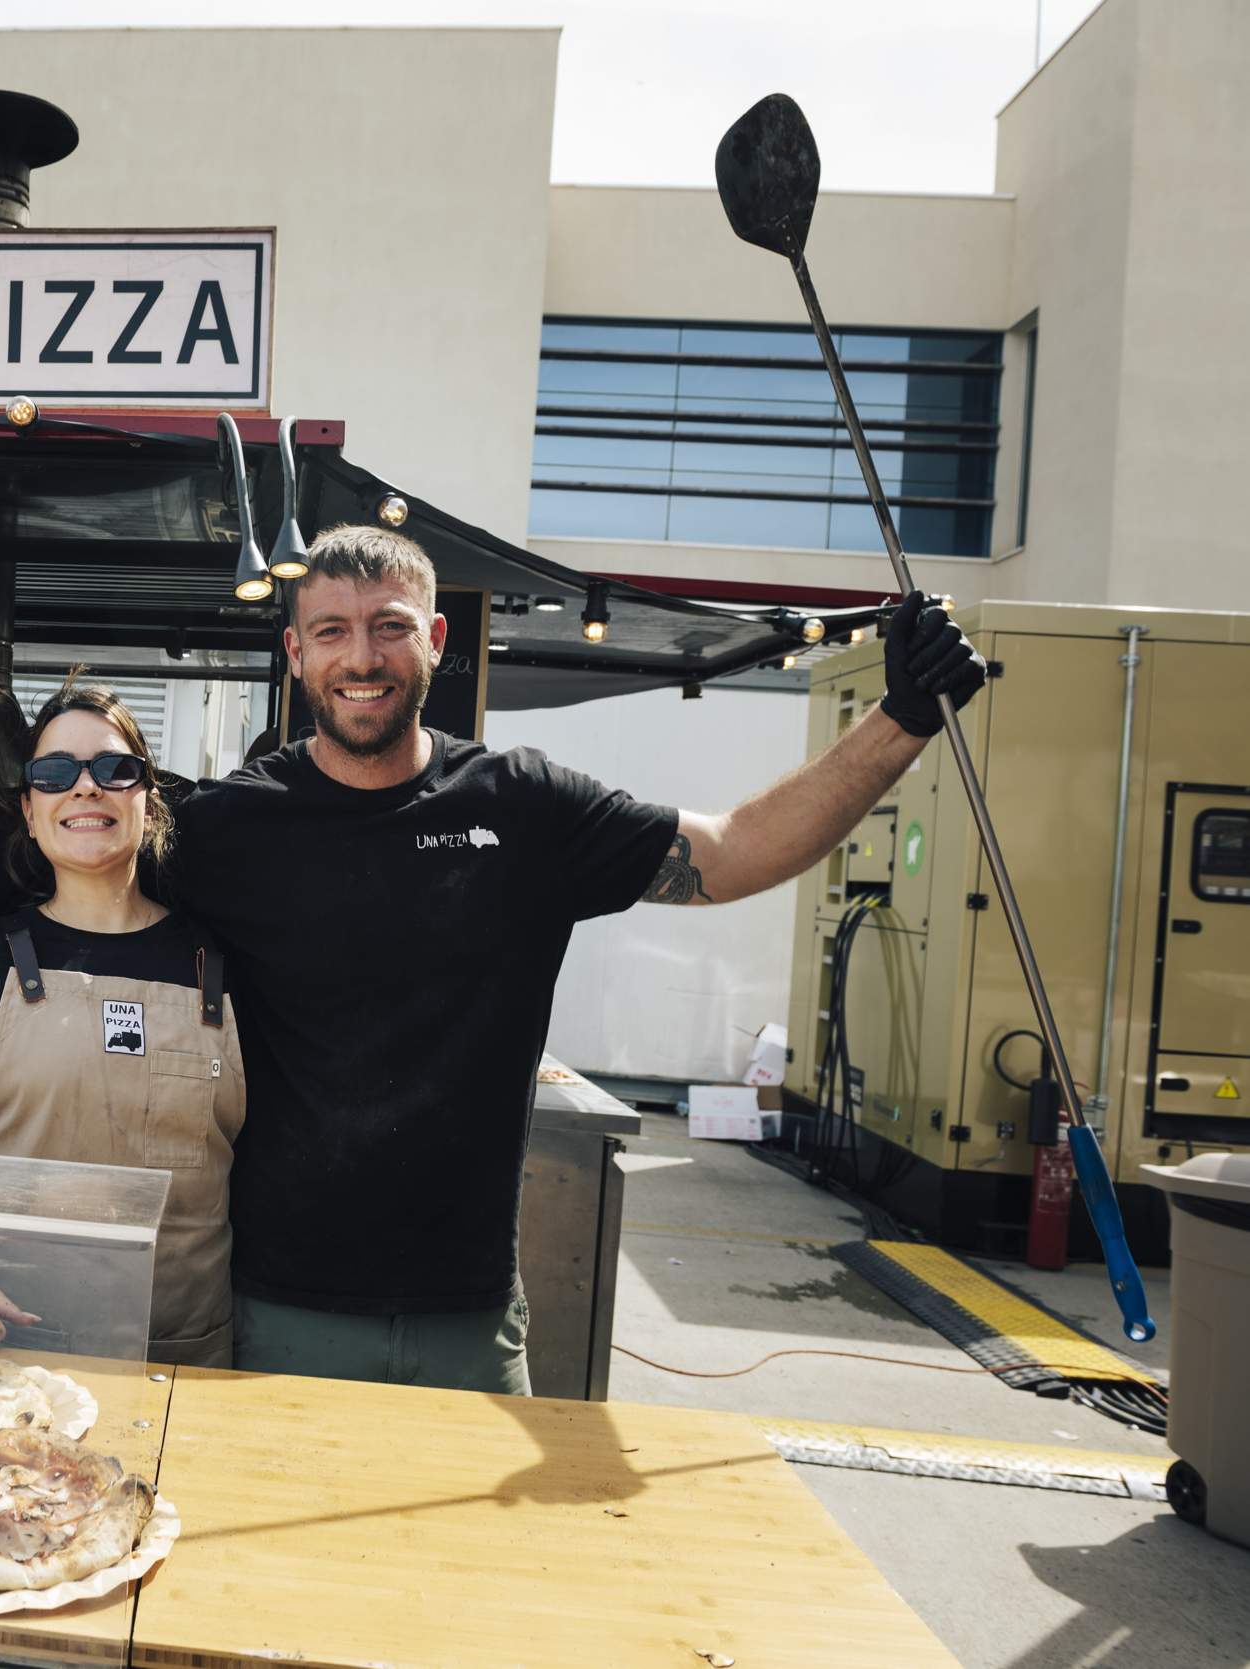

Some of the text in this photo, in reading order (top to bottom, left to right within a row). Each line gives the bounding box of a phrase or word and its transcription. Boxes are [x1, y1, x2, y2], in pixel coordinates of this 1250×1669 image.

[416, 834, 439, 849] UNA
[109, 1003, 137, 1015] UNA
[105, 1017, 141, 1029] PIZZA
